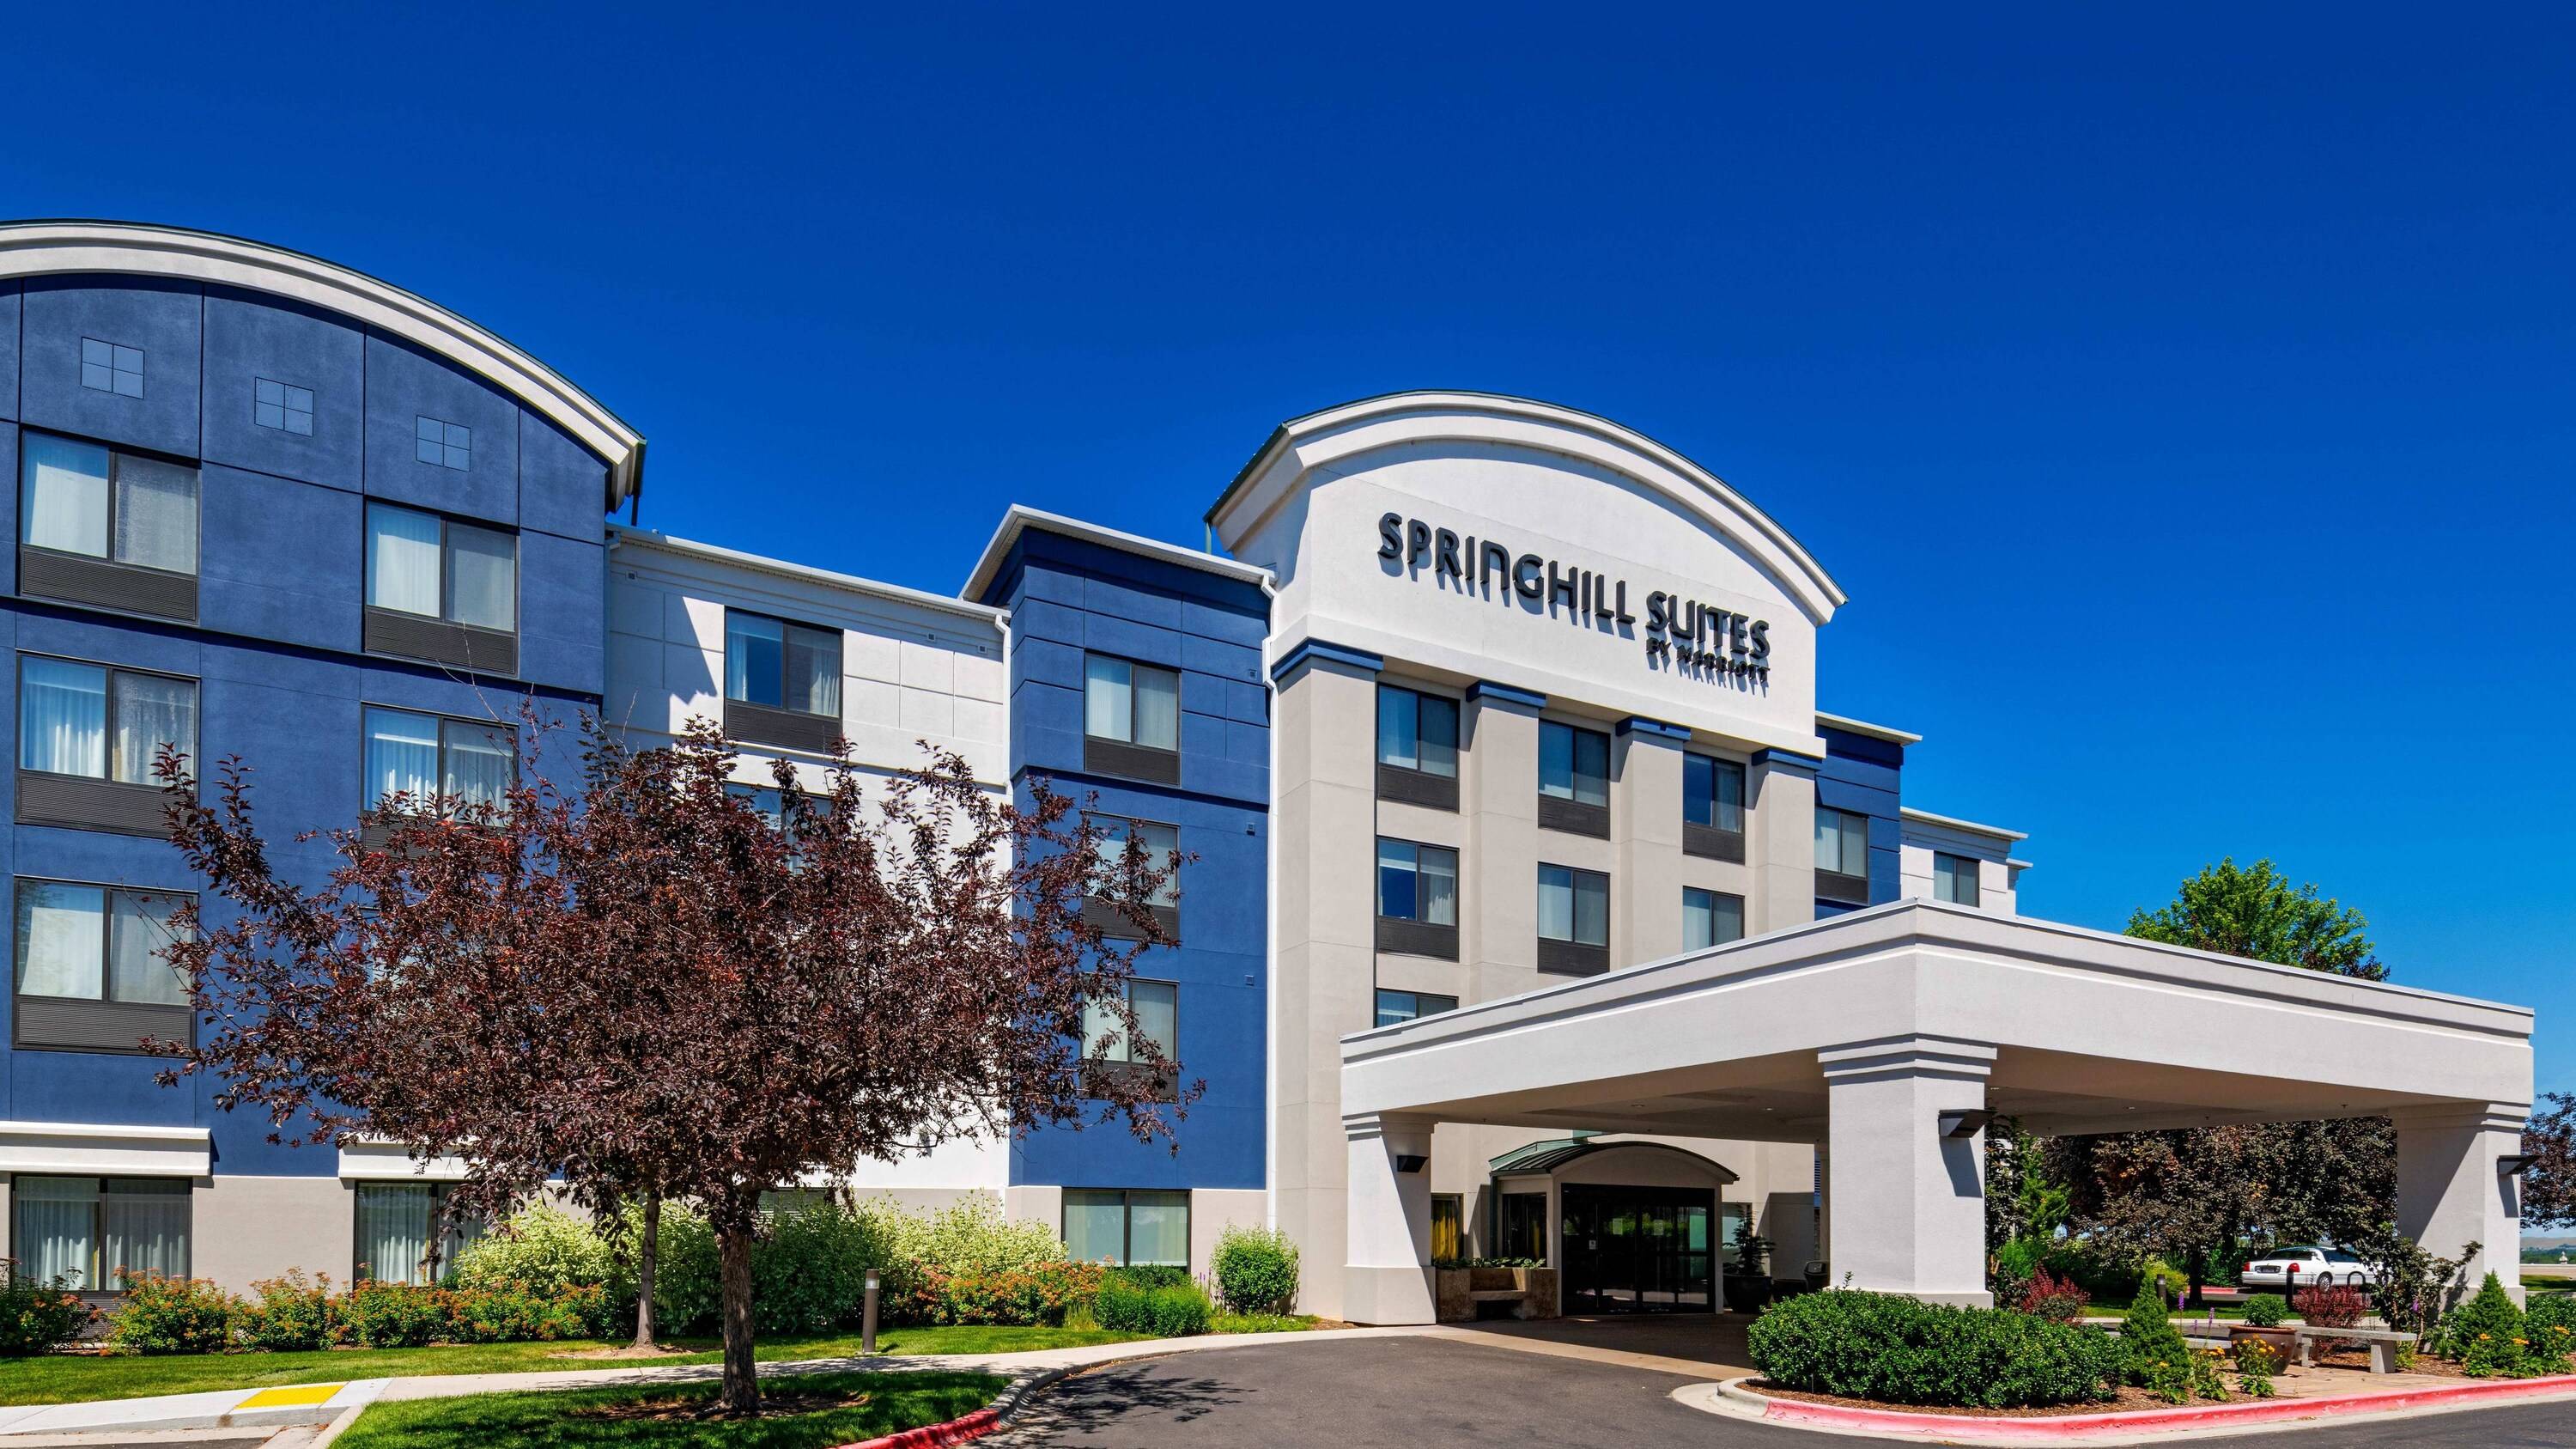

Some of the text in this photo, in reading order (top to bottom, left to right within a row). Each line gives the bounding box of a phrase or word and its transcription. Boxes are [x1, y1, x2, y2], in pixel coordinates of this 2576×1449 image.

[1376, 512, 1771, 660] SPRINGHILL SUITES
[1646, 636, 1771, 683] BY MARRIOTT
